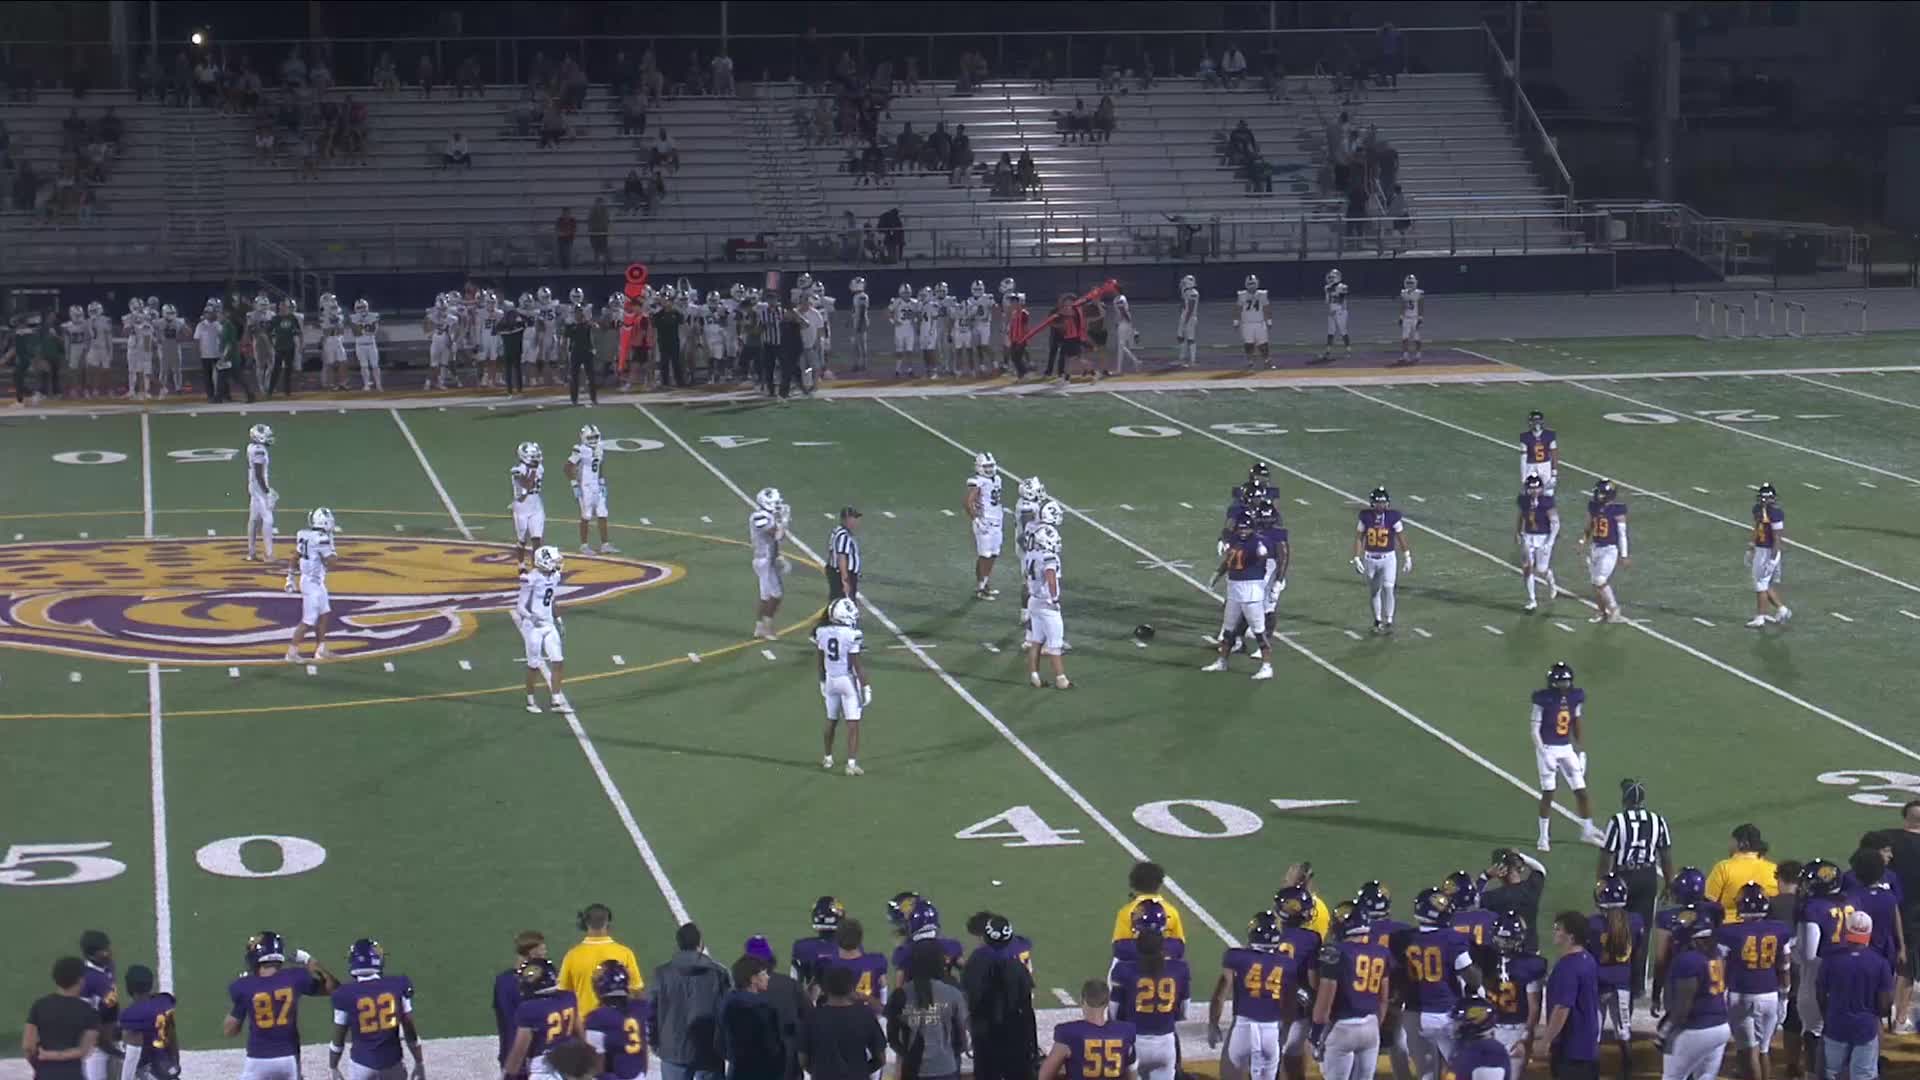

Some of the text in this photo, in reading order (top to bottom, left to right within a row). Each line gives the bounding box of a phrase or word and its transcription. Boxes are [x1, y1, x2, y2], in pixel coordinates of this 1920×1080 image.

[827, 637, 840, 662] 9
[855, 971, 872, 996] 4
[1244, 962, 1284, 1000] 44
[1353, 954, 1385, 993] 98
[254, 987, 294, 1029] 87
[357, 993, 397, 1033] 22
[1135, 977, 1177, 1013] 29
[546, 1007, 576, 1042] 27
[624, 1017, 641, 1054] 3
[1082, 1039, 1123, 1078] 55
